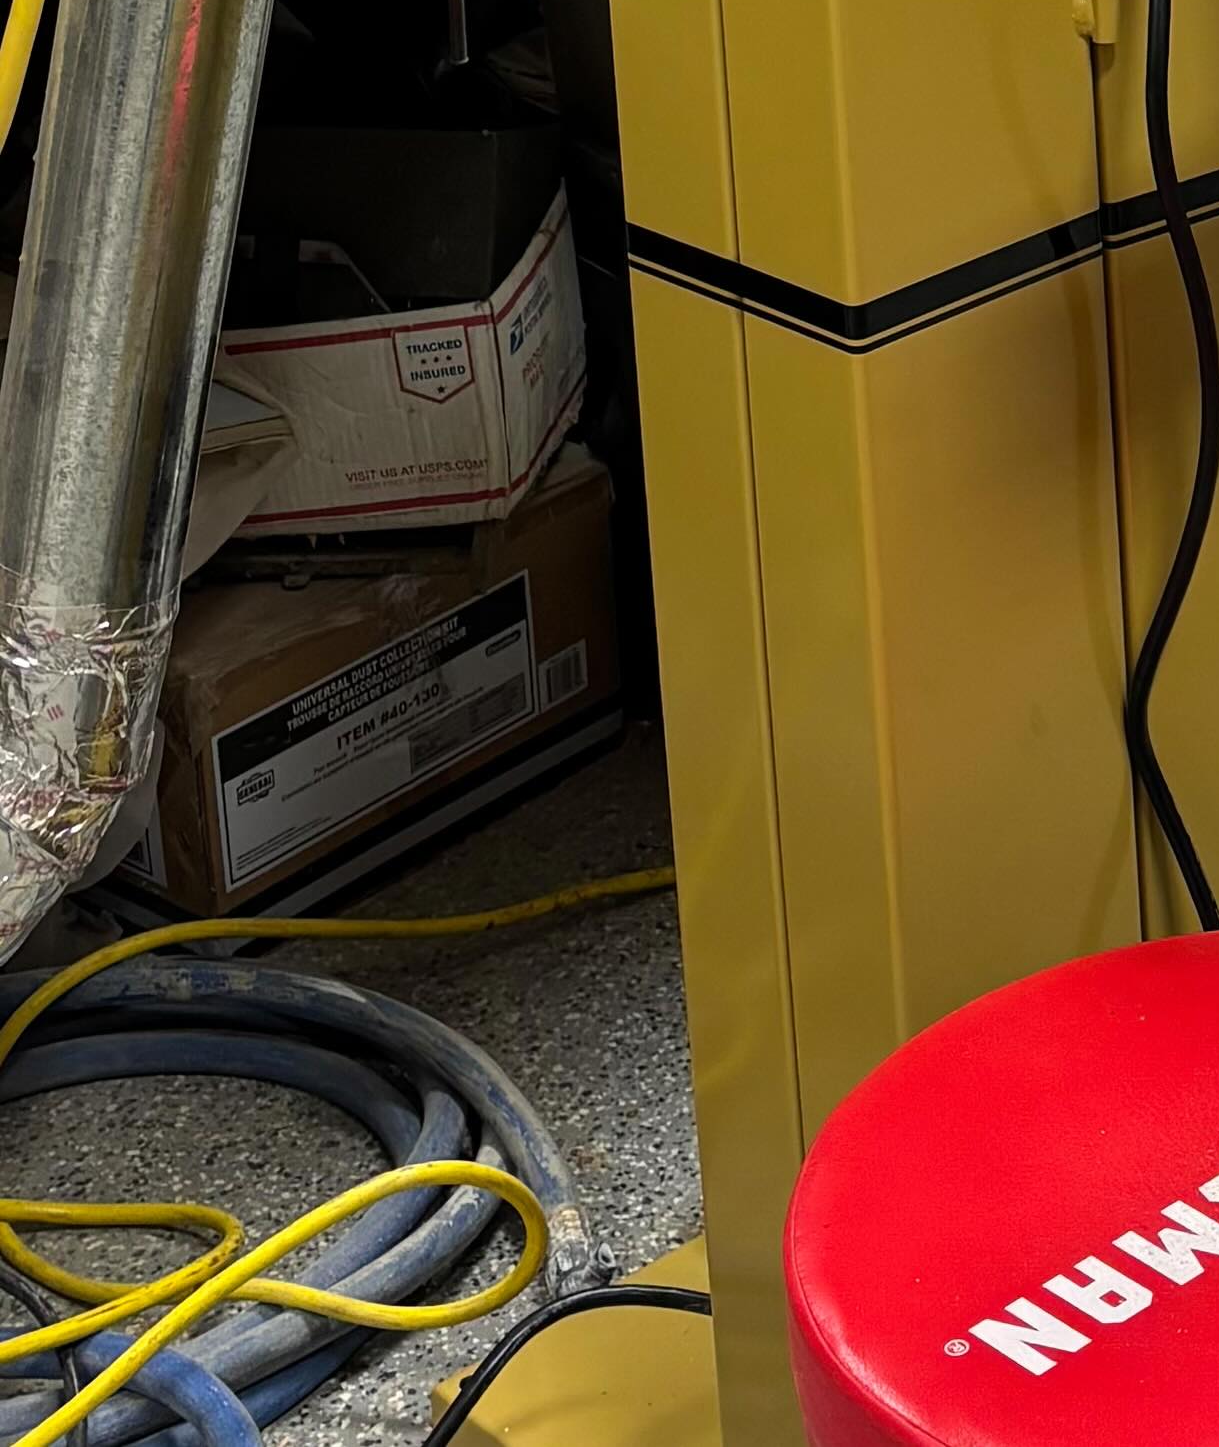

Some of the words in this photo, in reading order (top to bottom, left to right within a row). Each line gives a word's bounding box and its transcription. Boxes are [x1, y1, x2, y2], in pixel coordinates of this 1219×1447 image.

[405, 338, 463, 358] TRACKED
[410, 365, 466, 382] INSURED
[345, 469, 377, 482] VISIT
[380, 467, 398, 478] US
[400, 465, 416, 476] AT
[292, 676, 350, 715] UNIVERSAL
[351, 660, 378, 684] DUST
[336, 720, 376, 750] ITEM
